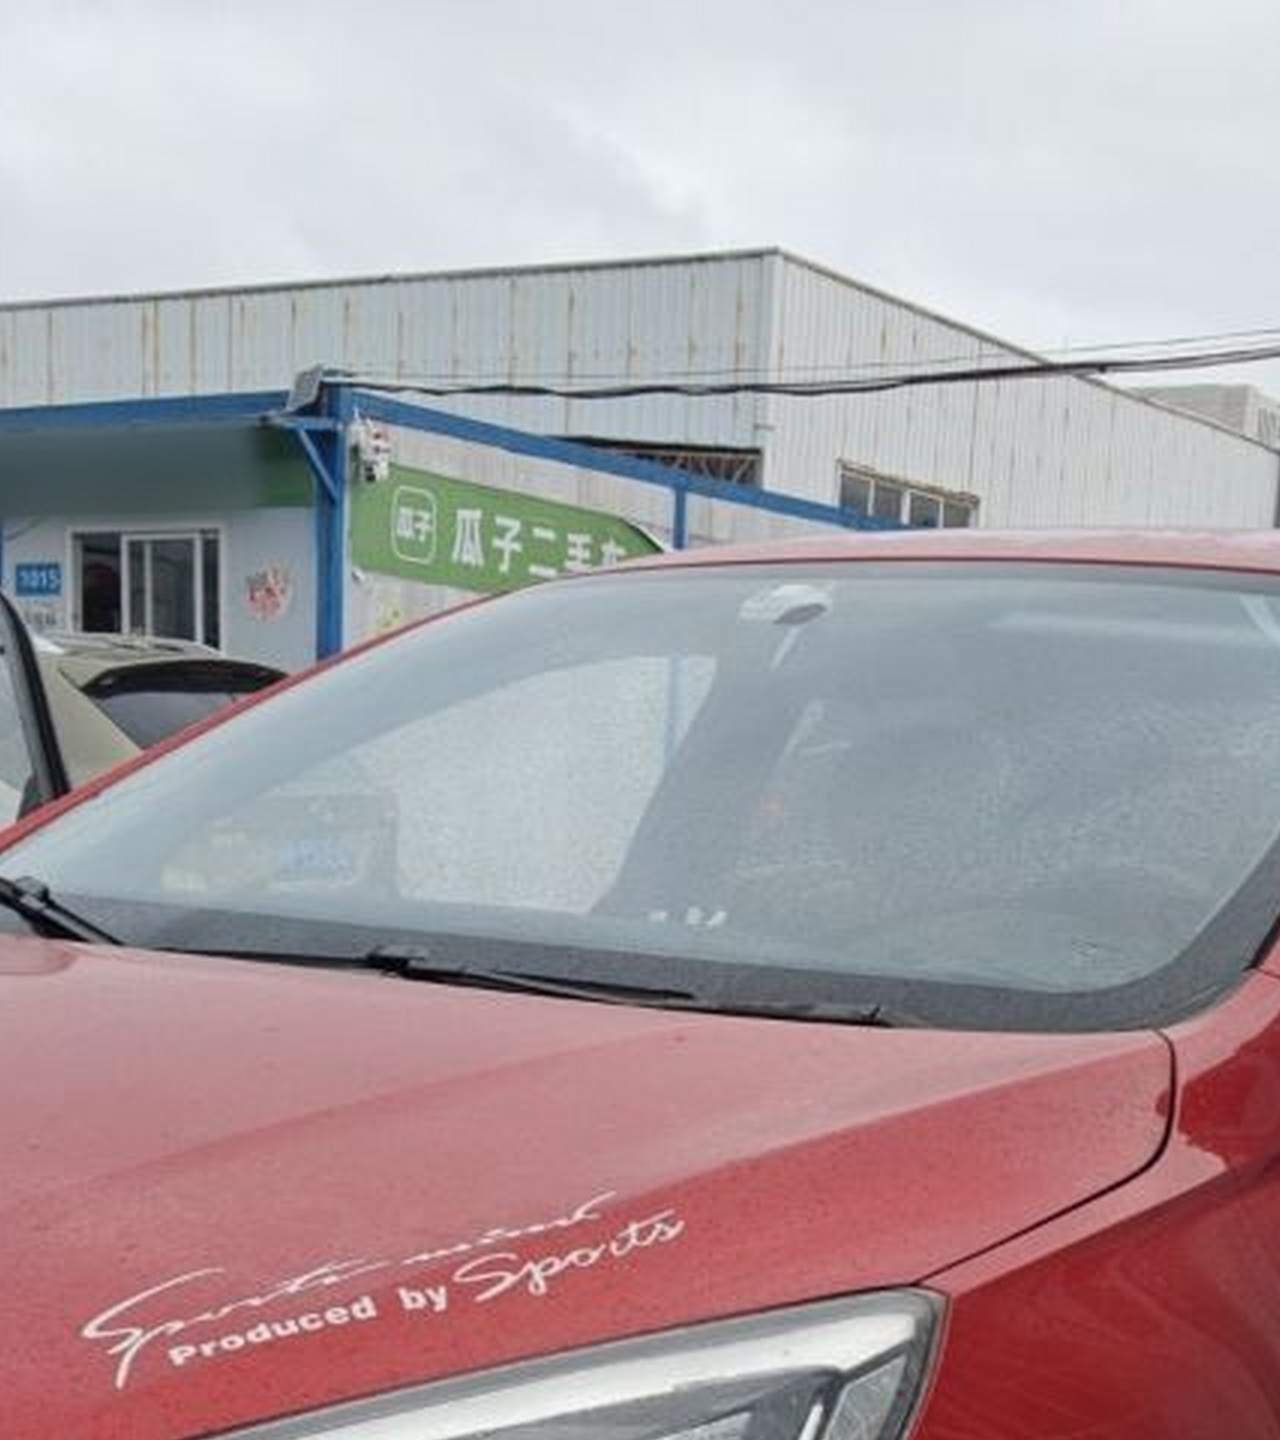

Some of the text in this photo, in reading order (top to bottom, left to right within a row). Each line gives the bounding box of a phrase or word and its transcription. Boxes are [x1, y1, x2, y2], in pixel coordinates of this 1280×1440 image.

[396, 505, 434, 543] 瓜子
[167, 1209, 686, 1366] Produced by Sports
